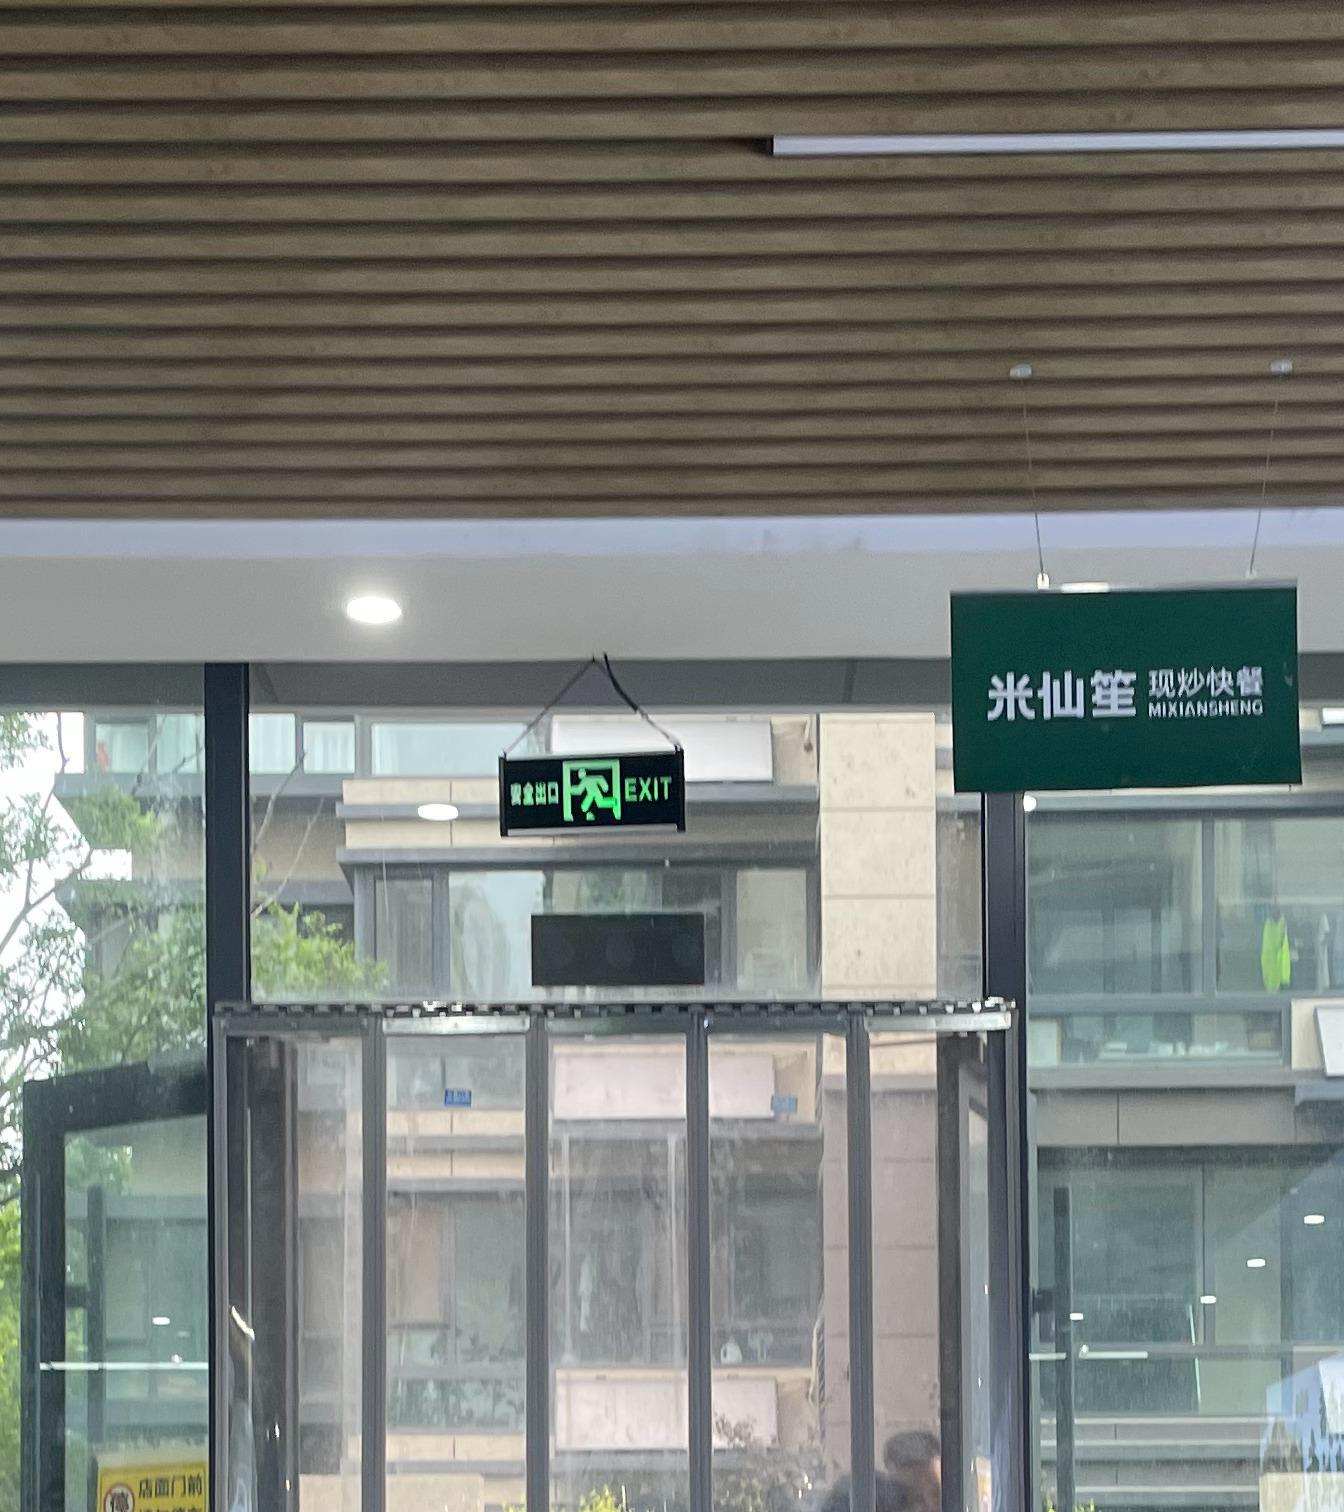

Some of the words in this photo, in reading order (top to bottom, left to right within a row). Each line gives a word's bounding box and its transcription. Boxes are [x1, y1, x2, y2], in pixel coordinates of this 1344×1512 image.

[987, 669, 1137, 721] 米仙笙
[1149, 665, 1265, 698] 现炒快餐
[1148, 698, 1264, 719] MIXIANSHENG
[624, 776, 672, 803] EXIT
[139, 1475, 203, 1499] 店面门前
